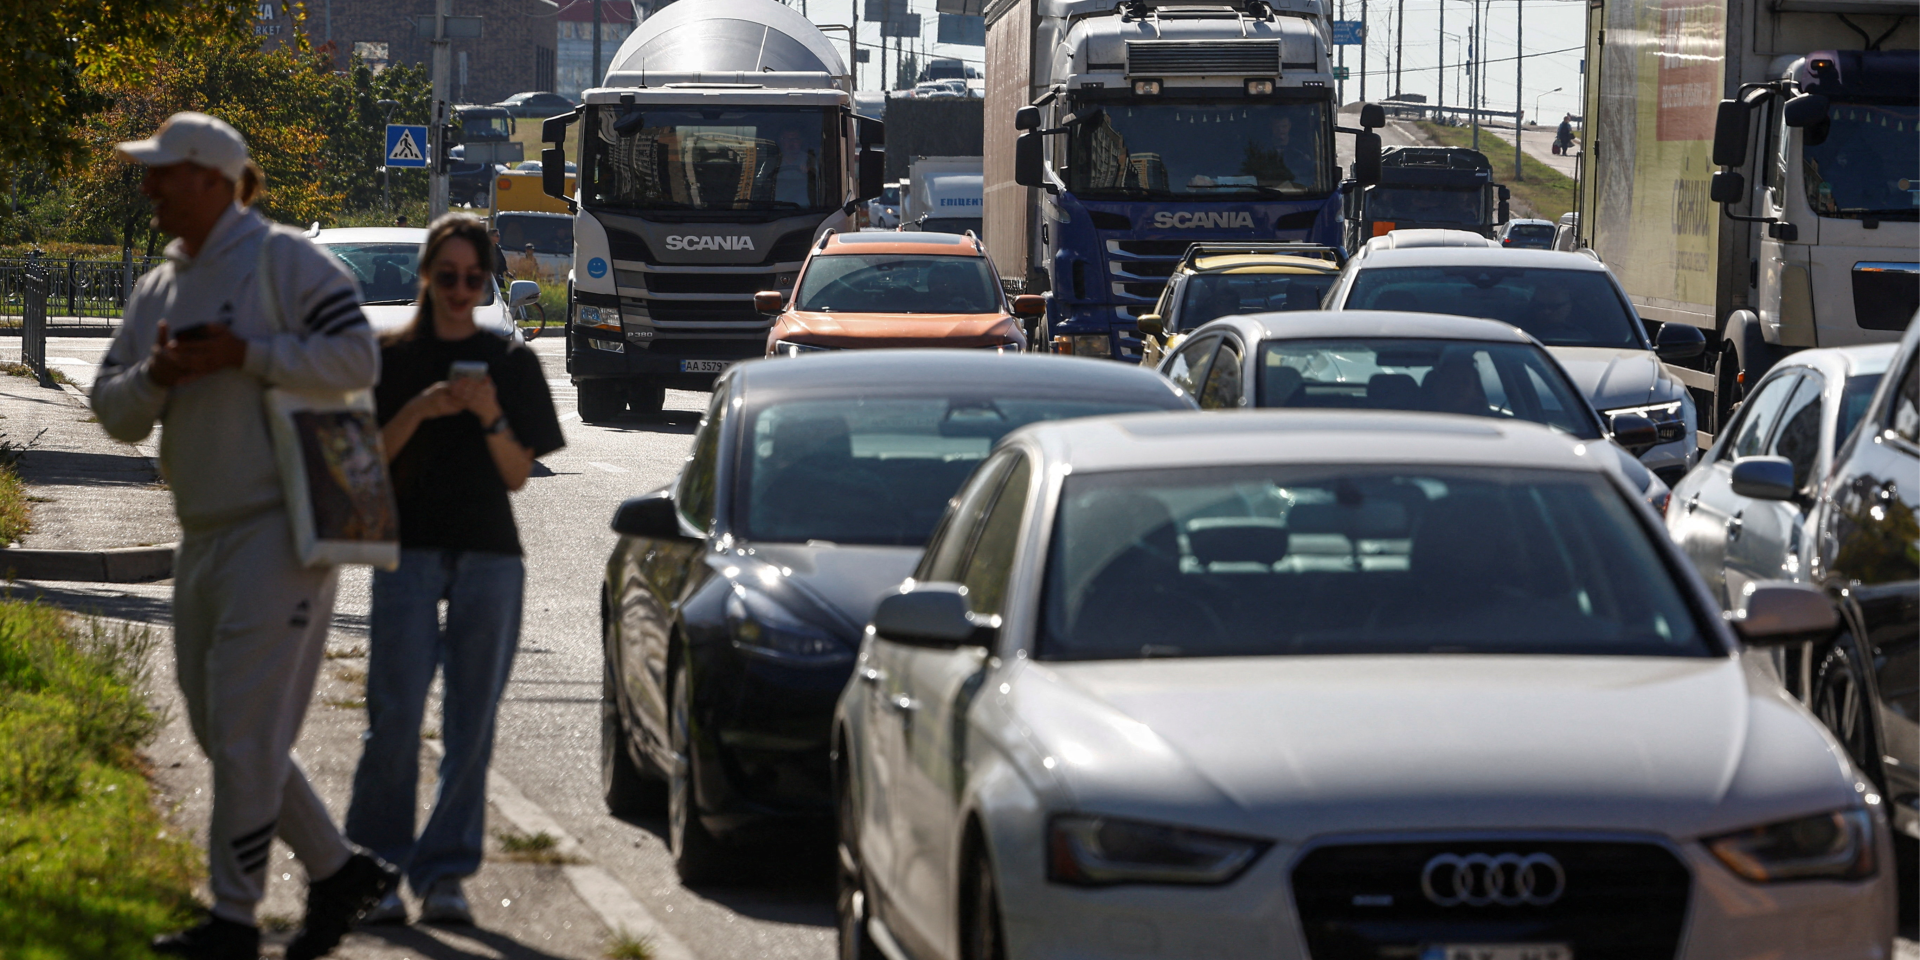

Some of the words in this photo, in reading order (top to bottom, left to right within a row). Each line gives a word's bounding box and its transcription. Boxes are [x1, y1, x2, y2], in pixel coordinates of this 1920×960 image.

[1153, 211, 1255, 229] SCANIA
[665, 234, 755, 251] SCANIA
[686, 361, 699, 371] AA
[701, 361, 723, 372] 3579
